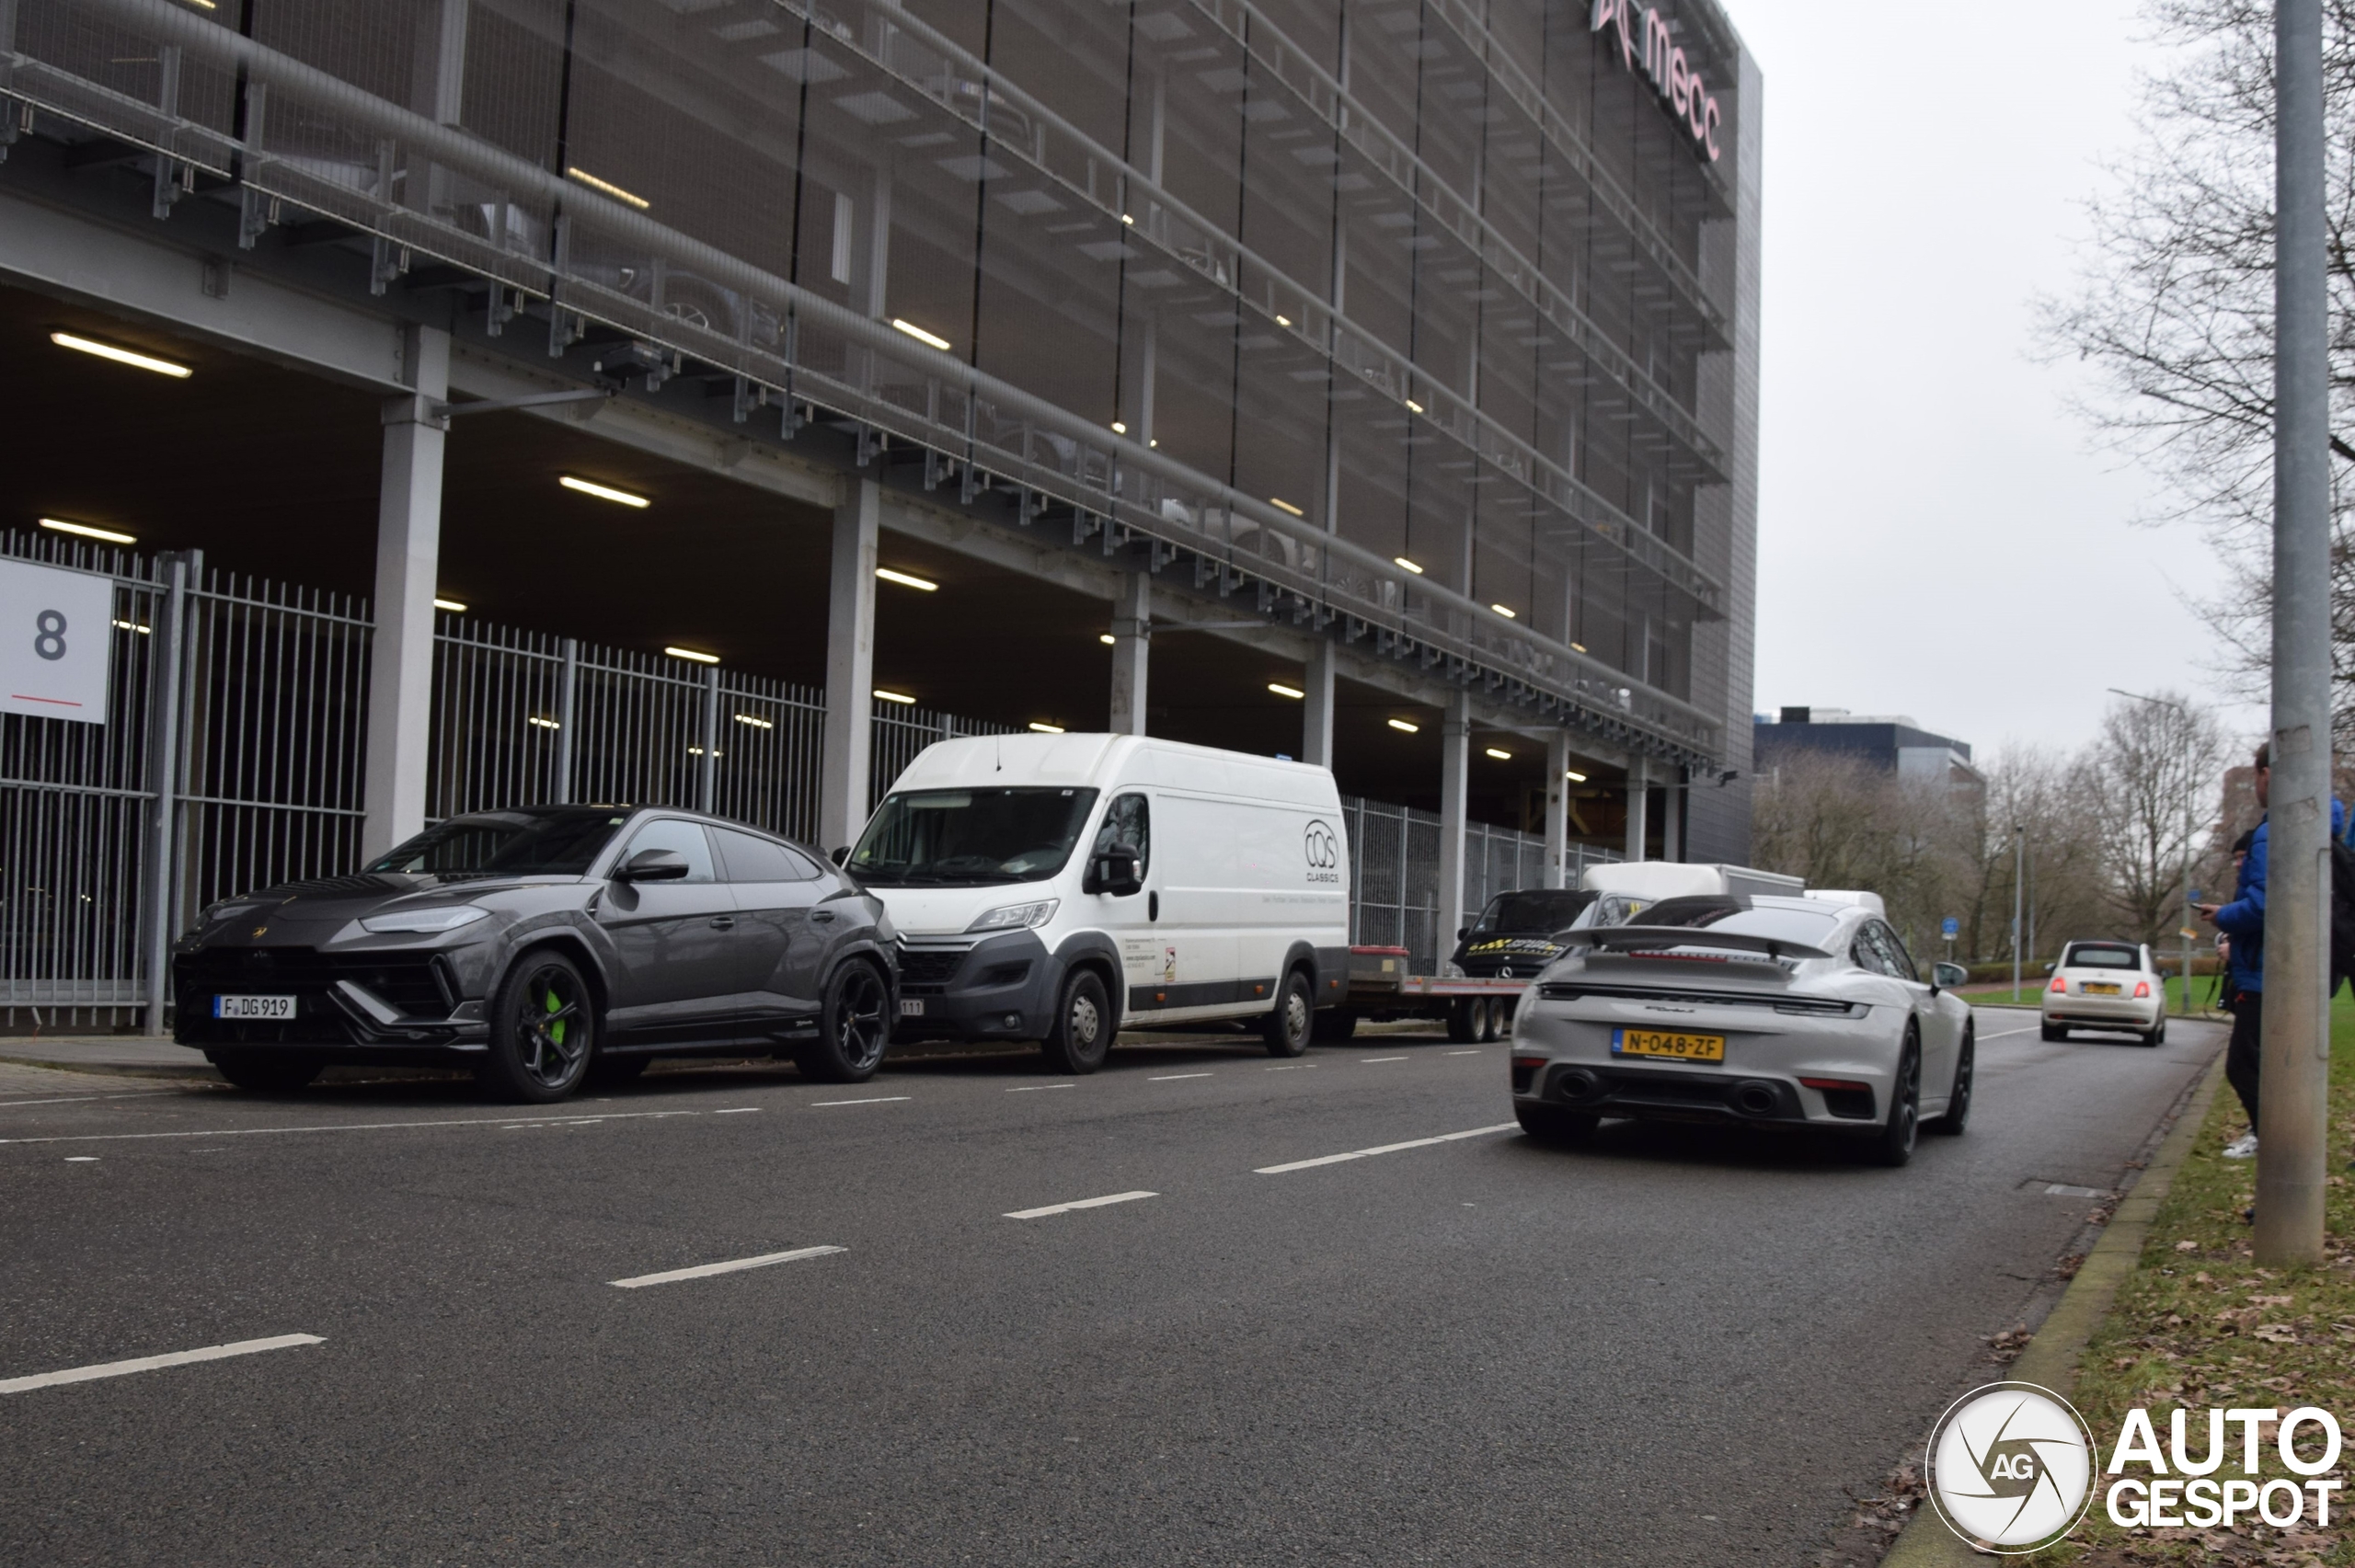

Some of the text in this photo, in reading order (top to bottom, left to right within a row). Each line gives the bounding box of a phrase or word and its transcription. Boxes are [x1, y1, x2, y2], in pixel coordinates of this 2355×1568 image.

[1644, 7, 1720, 162] mecc
[35, 609, 67, 661] 8
[1306, 872, 1339, 883] CLASSICS
[1629, 1033, 1717, 1057] N-048-ZF
